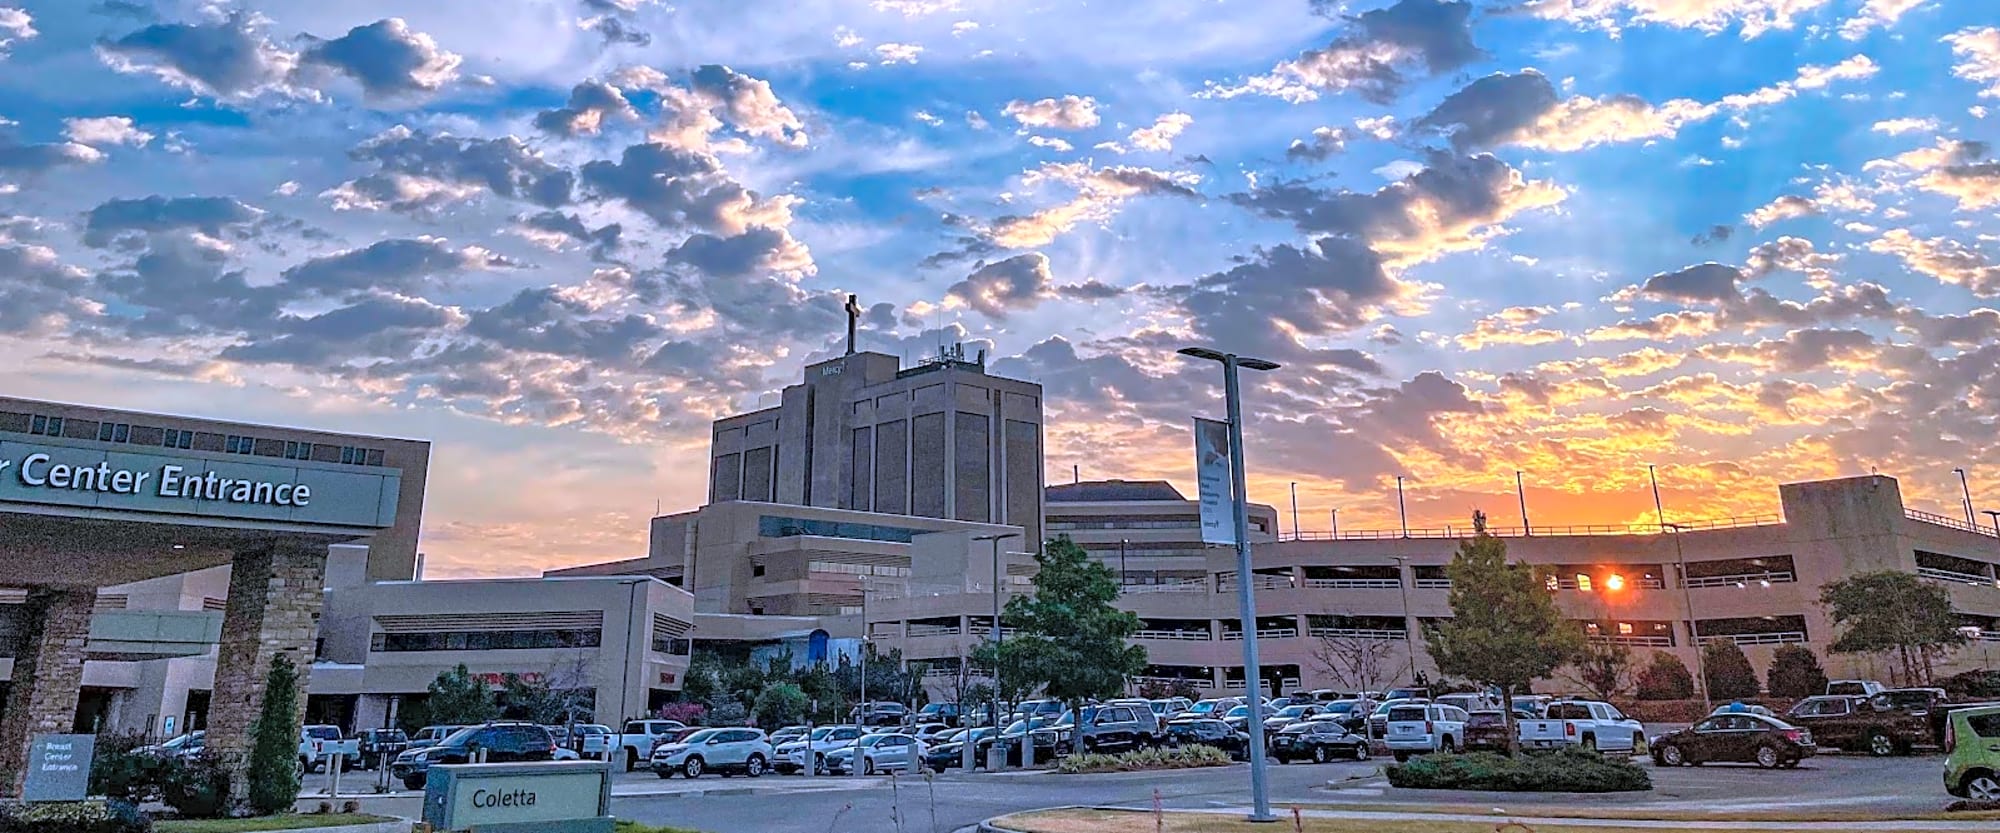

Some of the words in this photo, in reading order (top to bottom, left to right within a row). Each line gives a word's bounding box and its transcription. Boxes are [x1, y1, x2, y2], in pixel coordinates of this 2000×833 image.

[21, 452, 150, 494] Center
[159, 464, 311, 507] Entrance
[472, 787, 537, 809] Coletta
